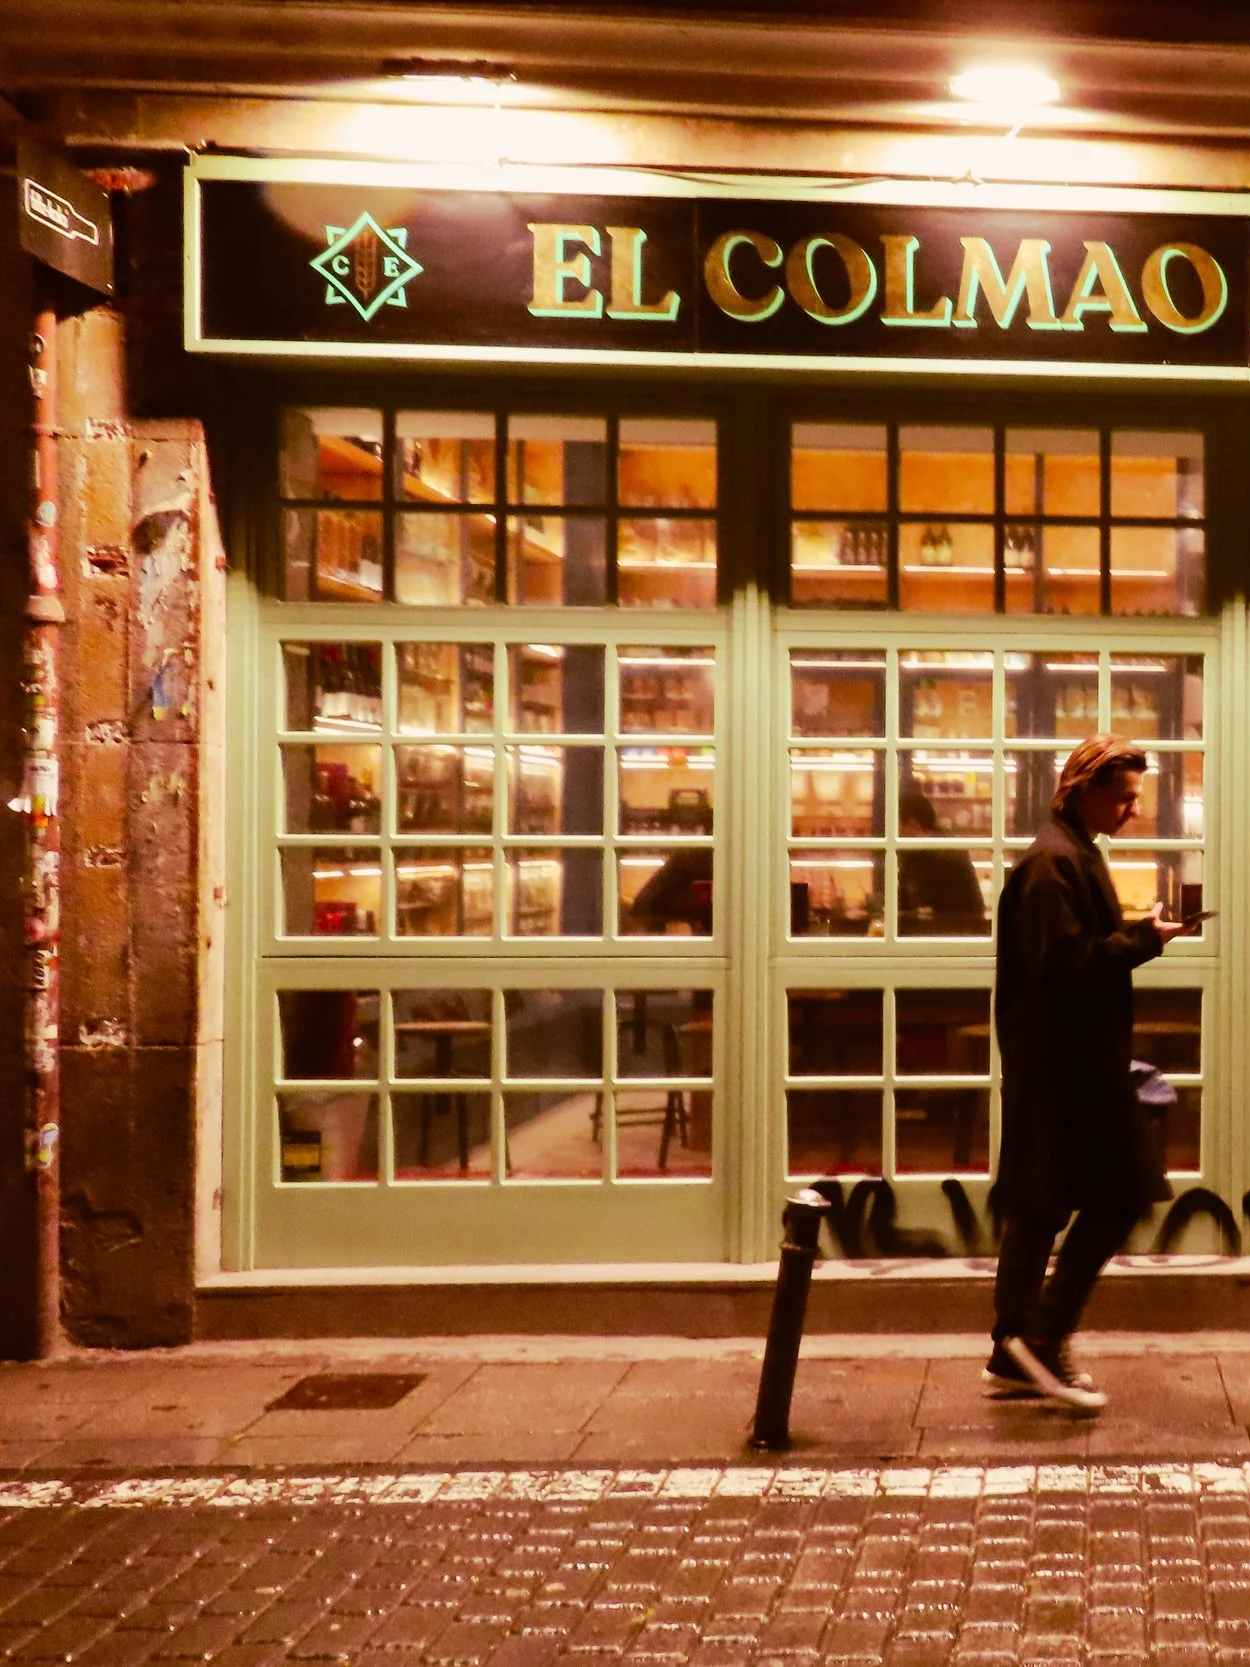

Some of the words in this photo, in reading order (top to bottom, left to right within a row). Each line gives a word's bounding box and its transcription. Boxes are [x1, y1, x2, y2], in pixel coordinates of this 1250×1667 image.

[332, 255, 349, 277] C
[383, 255, 401, 277] E
[527, 222, 681, 321] EL
[704, 229, 1228, 334] COLMAO
